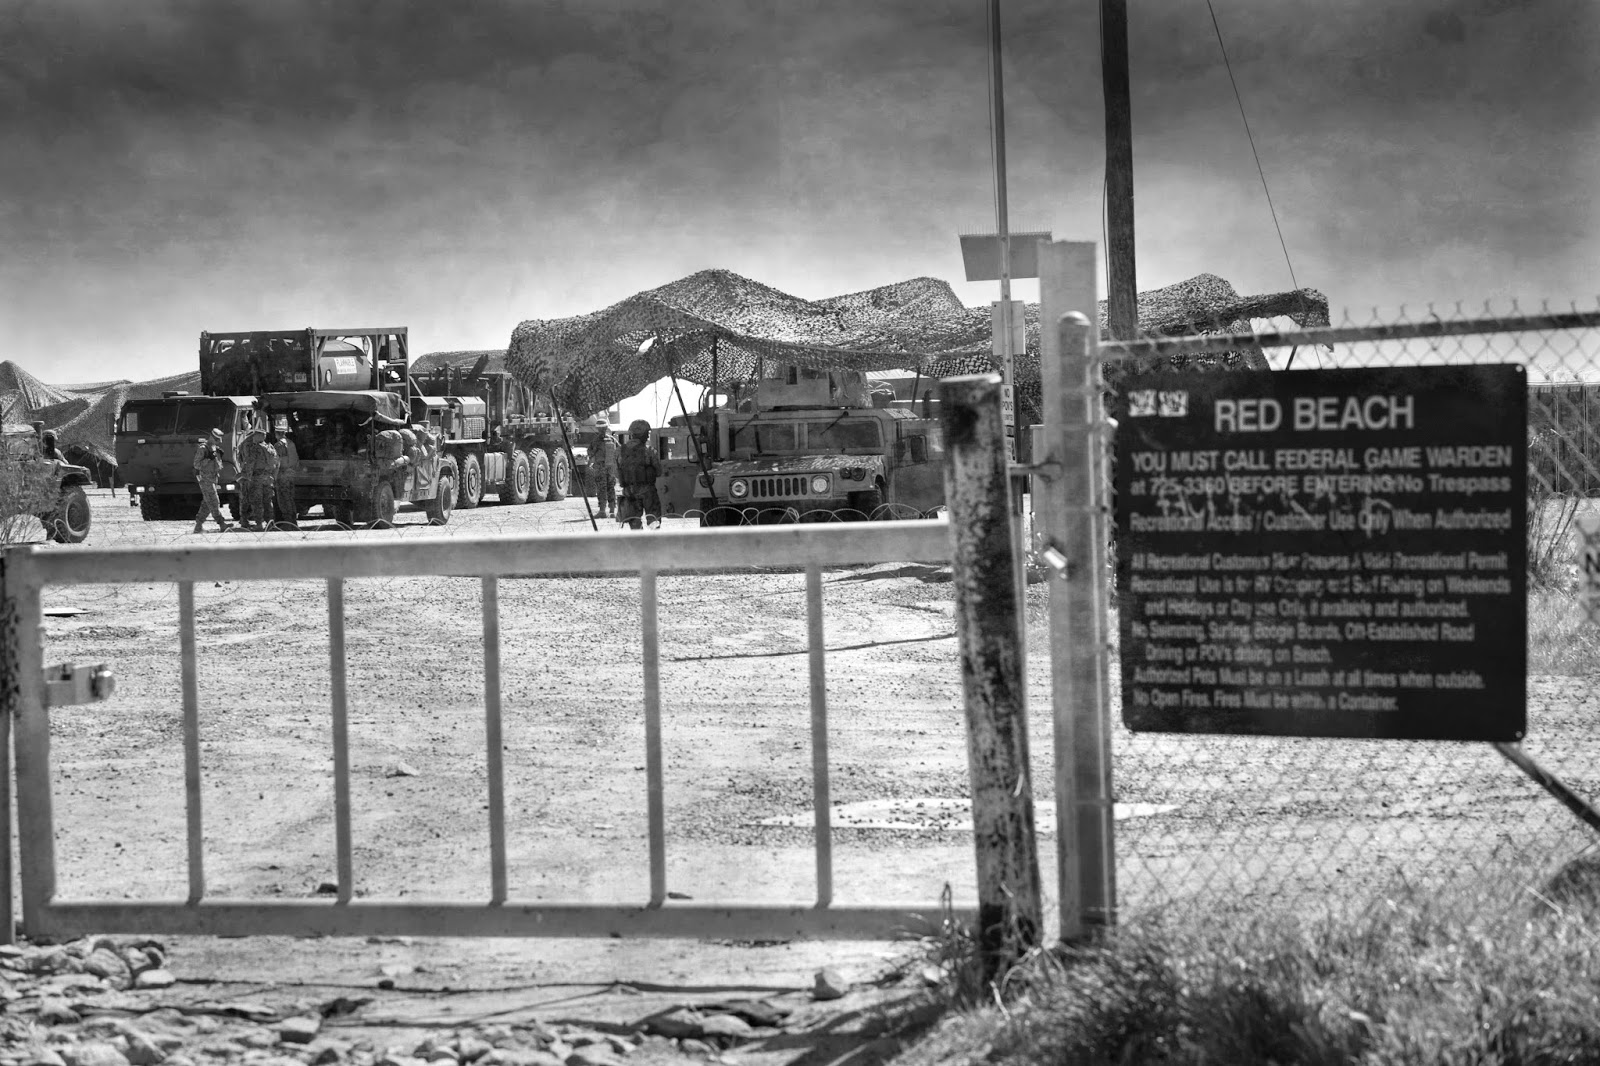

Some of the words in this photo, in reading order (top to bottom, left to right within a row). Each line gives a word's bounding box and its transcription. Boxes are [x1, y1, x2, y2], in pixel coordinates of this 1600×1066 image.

[1214, 399, 1282, 432] RED
[1294, 396, 1414, 431] BEACH
[1131, 452, 1166, 472] YOU
[1171, 451, 1218, 471] MUST
[1223, 450, 1270, 470] CALL
[1275, 448, 1360, 469] FEDERAL
[1365, 447, 1421, 468] GAME
[1427, 446, 1512, 467] WARDEN
[1130, 480, 1145, 495] at
[1228, 476, 1298, 493] BEFORE
[1428, 474, 1511, 495] Trespass
[1130, 512, 1204, 531] Recreational
[1329, 511, 1354, 530] Use
[1393, 510, 1432, 529] When
[1435, 508, 1511, 529] Authorized
[1468, 552, 1507, 569] Permit
[1427, 579, 1444, 593] on
[1447, 576, 1511, 593] Weekends
[1375, 599, 1399, 616] and
[1441, 623, 1475, 640] Road
